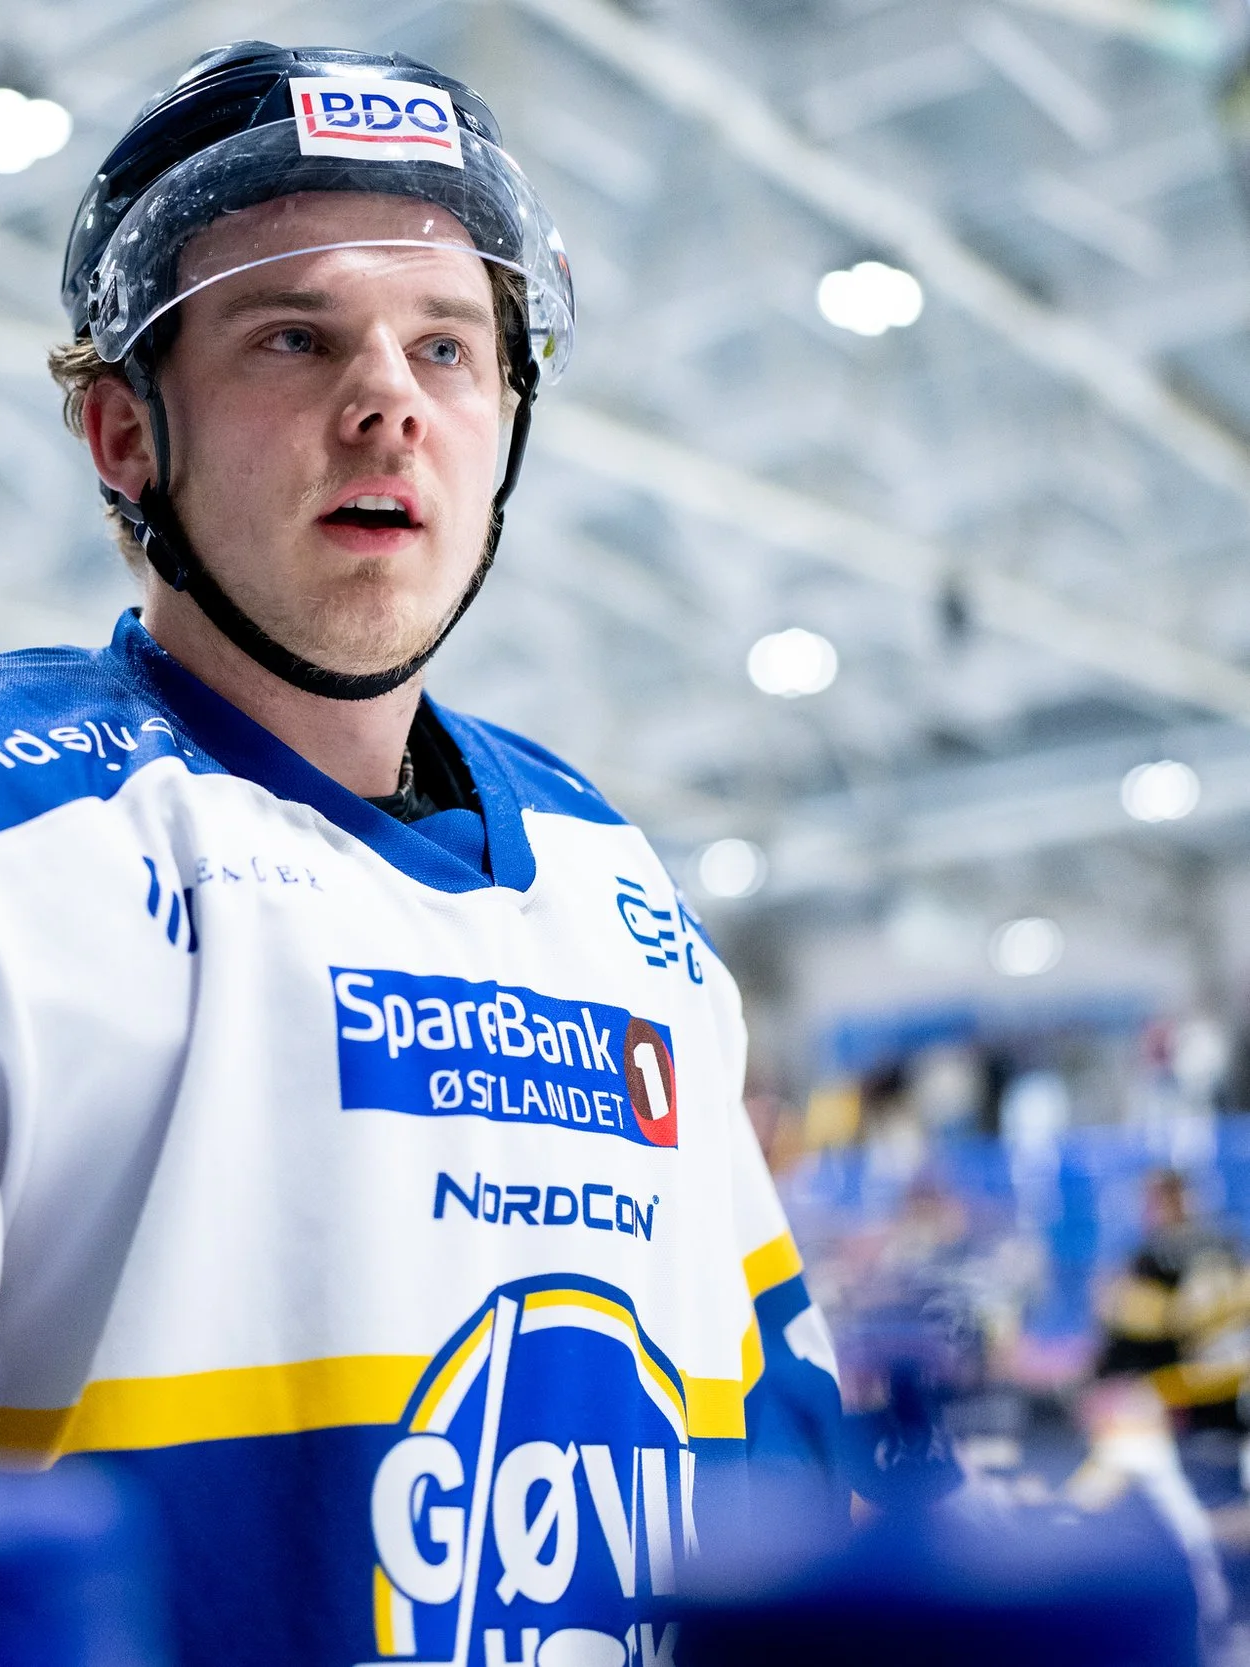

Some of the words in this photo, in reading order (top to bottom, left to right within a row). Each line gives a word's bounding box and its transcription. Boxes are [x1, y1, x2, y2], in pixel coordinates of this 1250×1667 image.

[319, 92, 449, 133] BDO
[334, 972, 618, 1075] SpareBank
[633, 1042, 670, 1121] 1
[429, 1069, 624, 1130] ØSTLANDET
